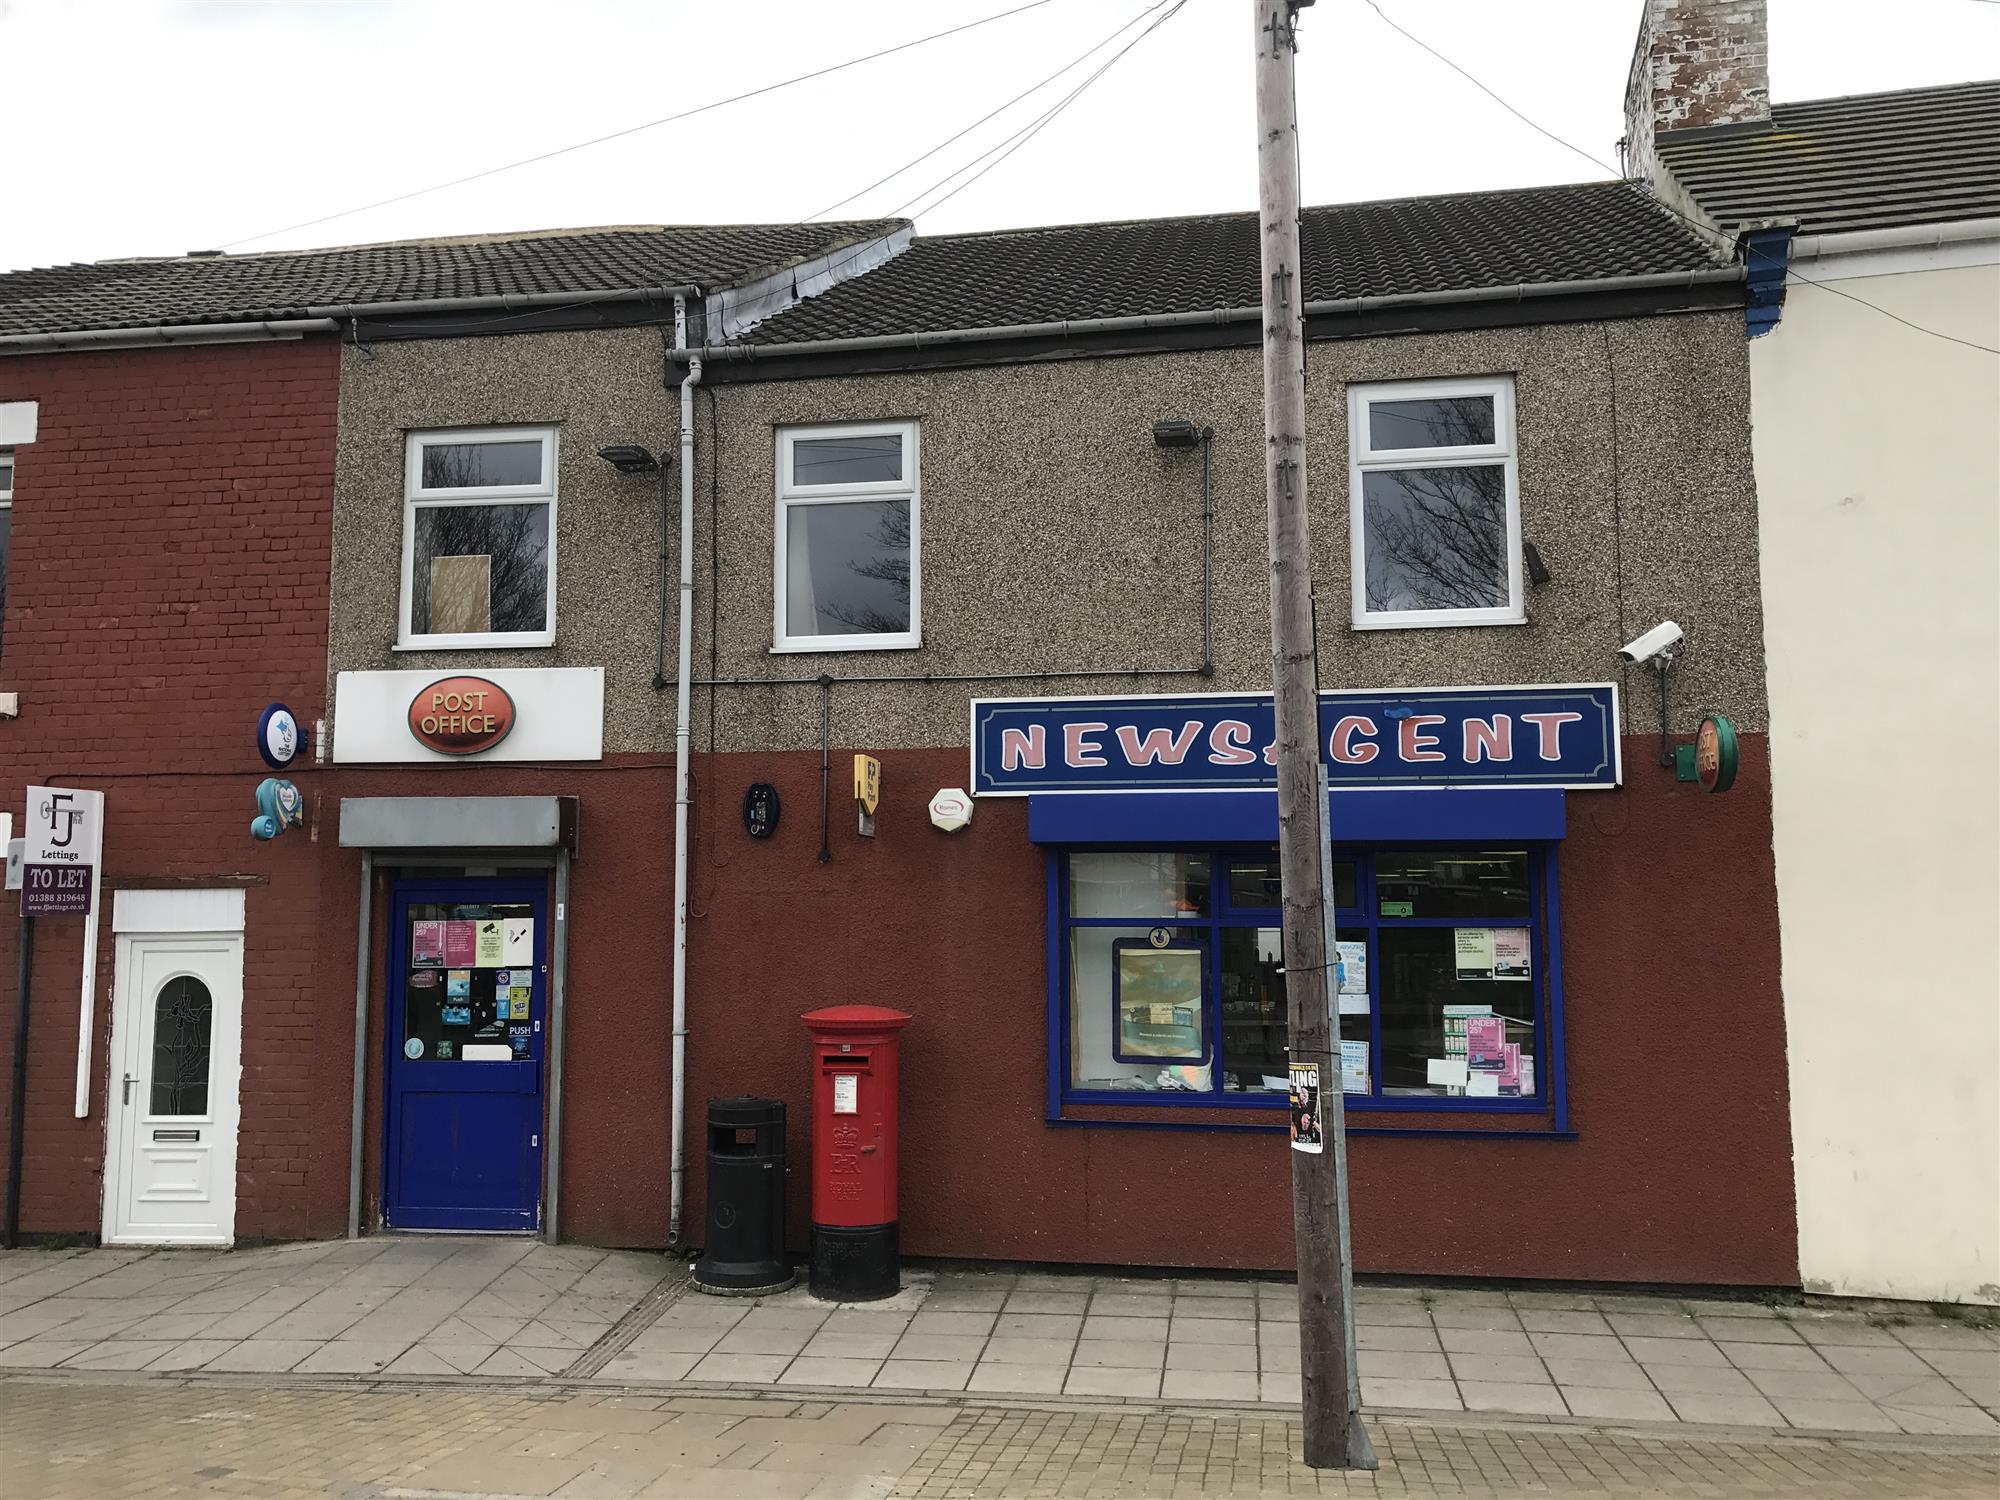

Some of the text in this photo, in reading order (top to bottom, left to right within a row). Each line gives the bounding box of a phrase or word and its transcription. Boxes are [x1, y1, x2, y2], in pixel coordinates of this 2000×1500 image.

[431, 691, 489, 712] POST
[421, 714, 496, 735] OFFICE
[1001, 712, 1583, 771] NEWSGENT
[42, 850, 79, 862] Lettings
[30, 868, 87, 888] TO LET
[509, 1026, 531, 1035] PUSH
[1469, 1019, 1496, 1027] UNDER
